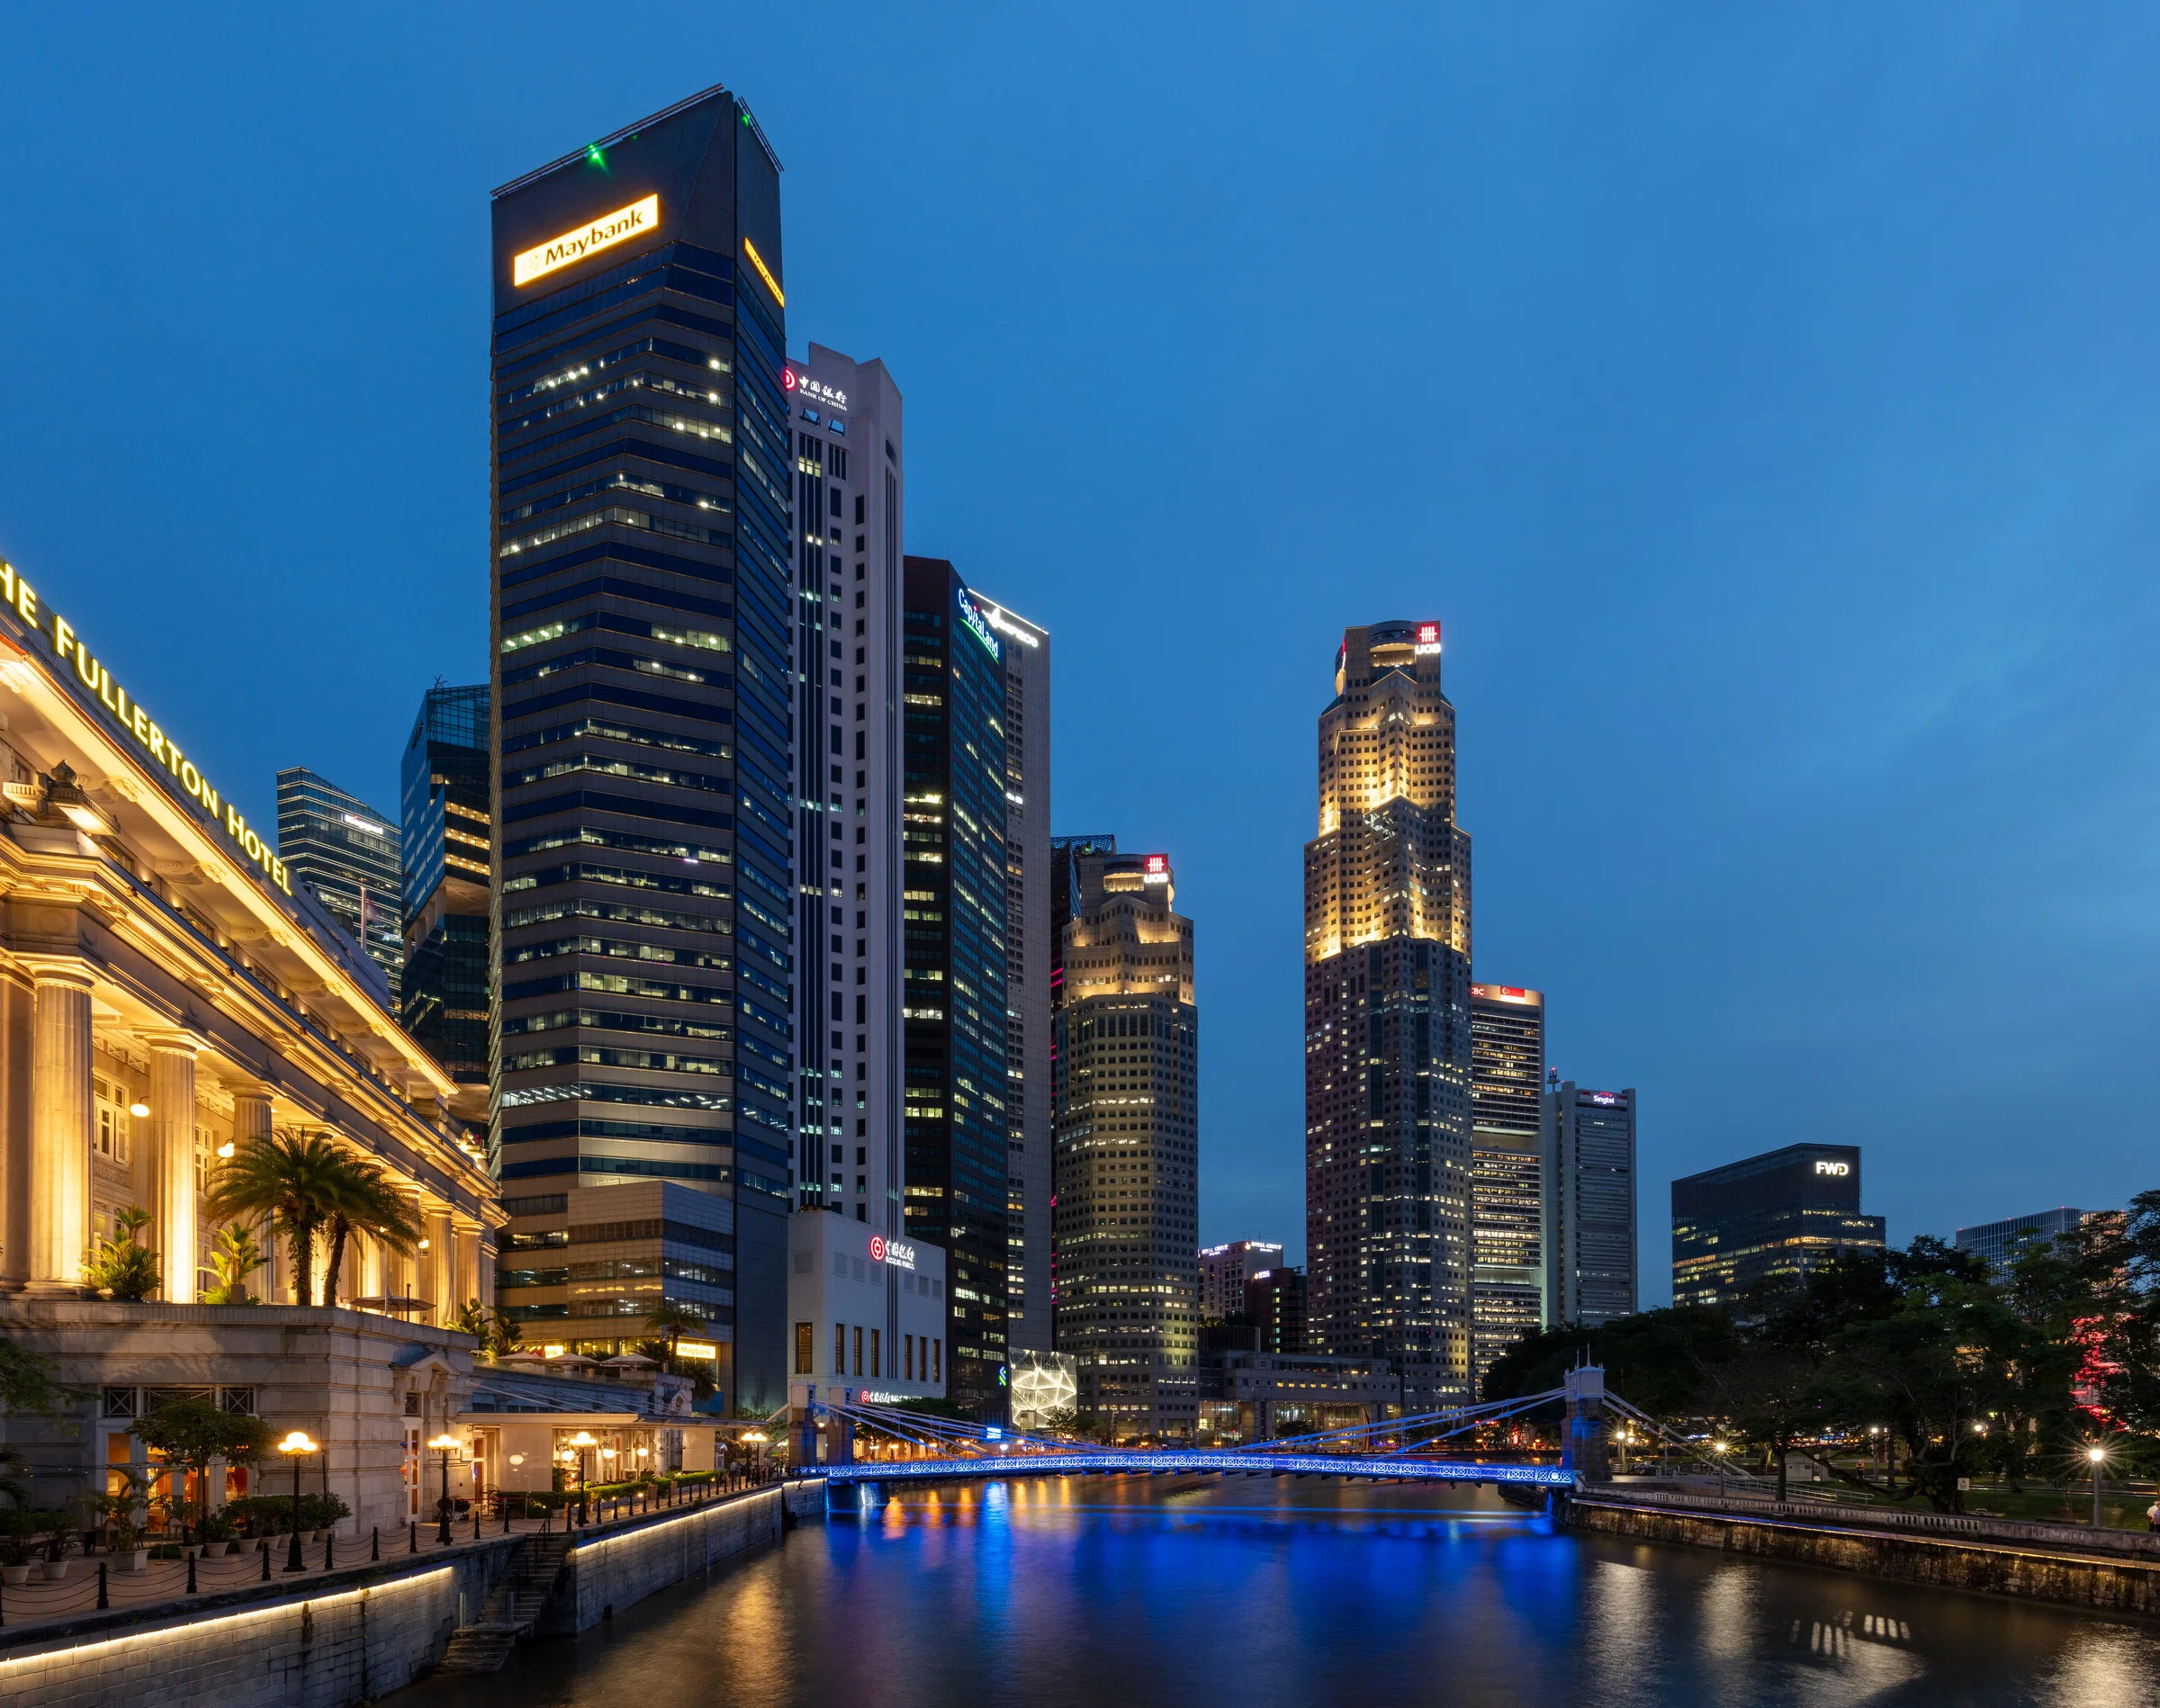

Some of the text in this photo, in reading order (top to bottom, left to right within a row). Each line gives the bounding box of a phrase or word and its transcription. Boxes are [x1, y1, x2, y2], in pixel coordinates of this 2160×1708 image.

[544, 209, 644, 266] Maybank
[799, 388, 817, 400] BANK
[827, 400, 848, 412] CHINA
[958, 588, 999, 659] CapitaLand
[1415, 643, 1442, 655] UOB
[54, 615, 220, 820] FULLERTON
[227, 803, 293, 897] HOTEL
[1144, 873, 1168, 884] UOB
[1593, 1095, 1615, 1105] Singtel
[1815, 1161, 1850, 1176] FWD
[680, 1346, 711, 1356] Maybank
